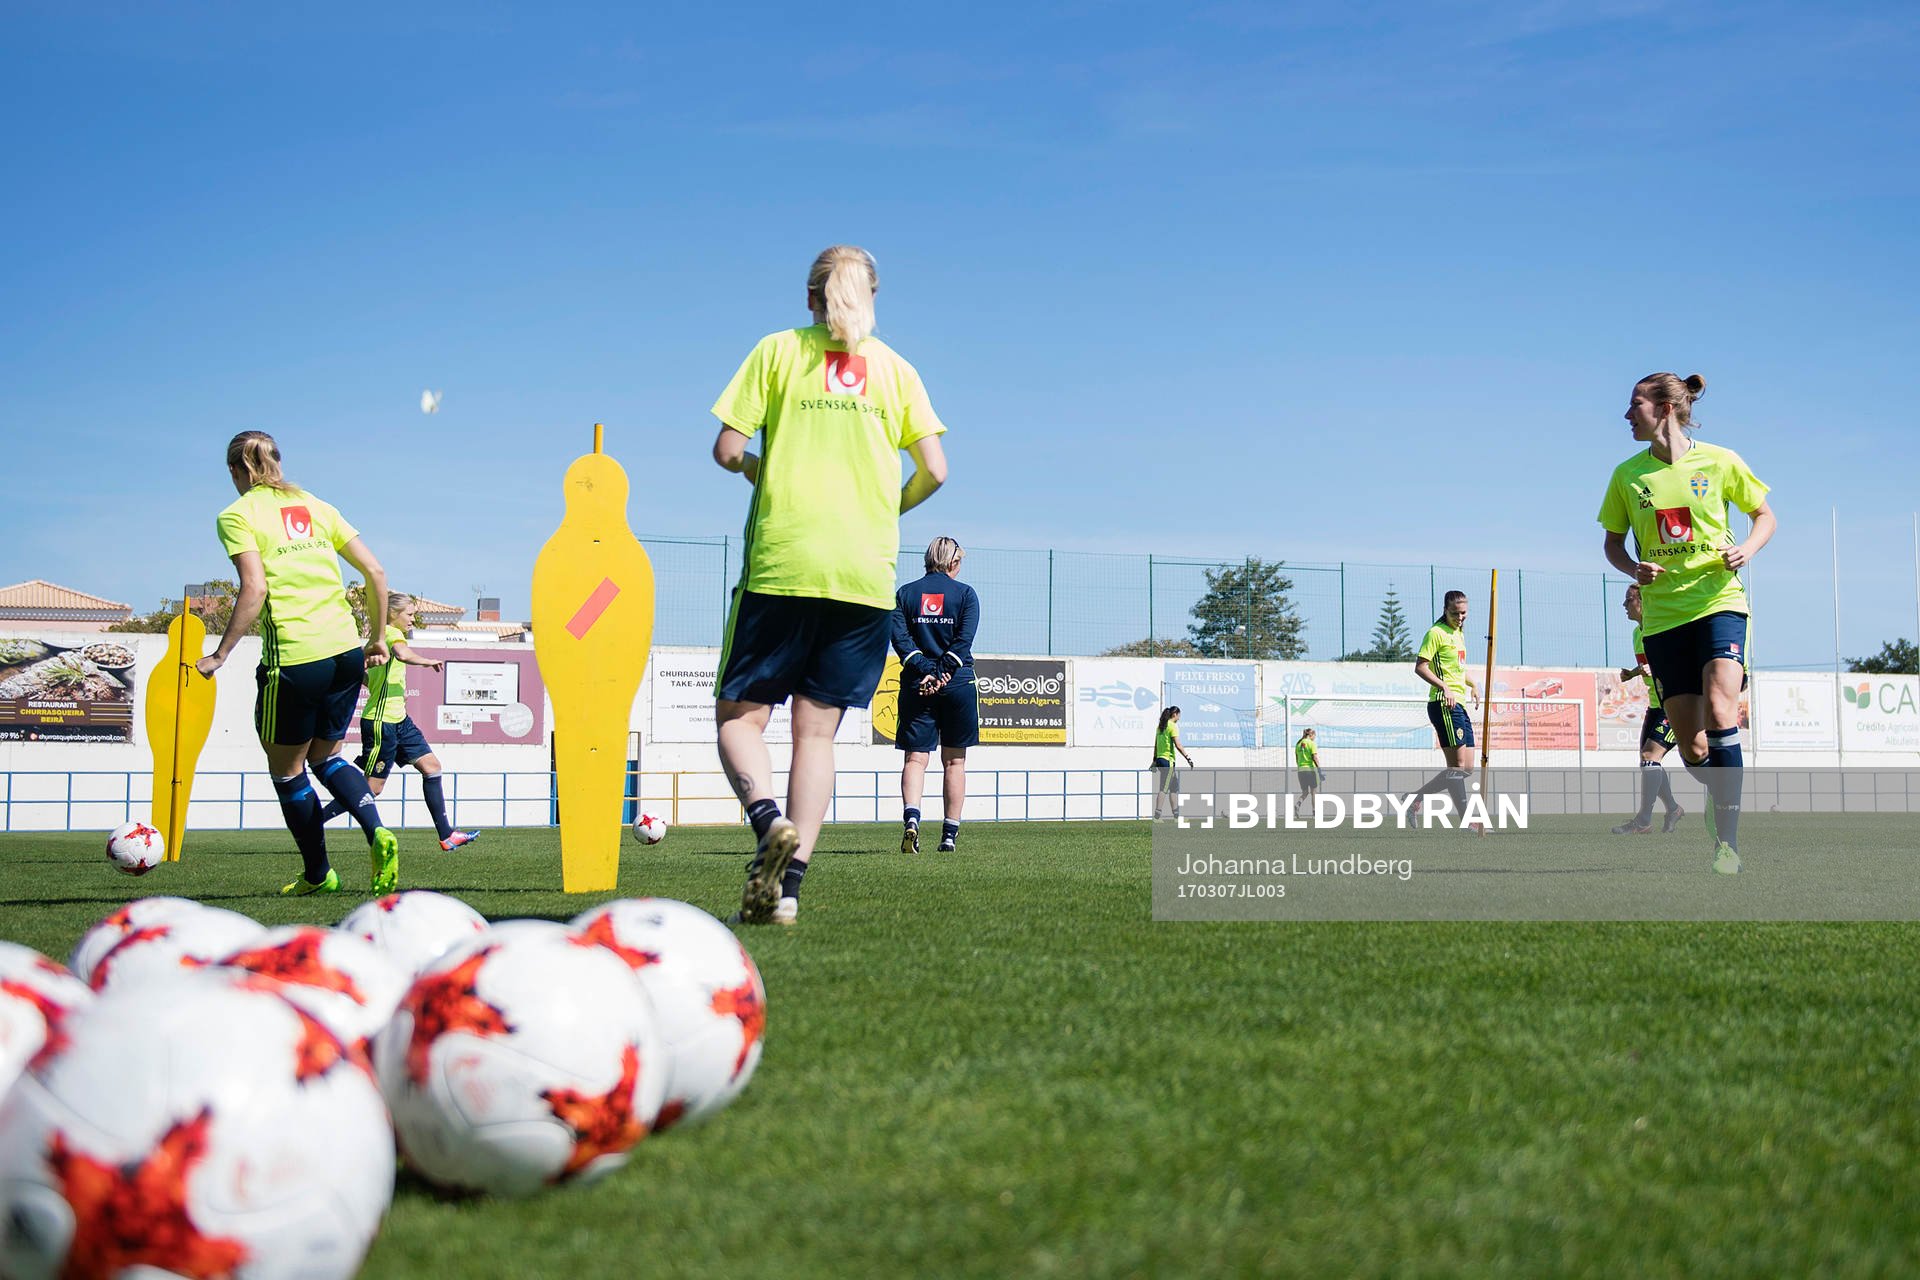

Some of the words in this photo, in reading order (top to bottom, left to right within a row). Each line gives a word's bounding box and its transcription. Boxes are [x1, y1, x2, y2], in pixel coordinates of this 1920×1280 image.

[800, 399, 858, 411] SVENSKA
[1639, 499, 1655, 510] ICA
[1649, 544, 1688, 558] SVENSKA
[659, 670, 717, 678] CHURRASQUE
[1175, 671, 1205, 681] PEIXE
[1206, 671, 1246, 682] FRESCO
[977, 674, 1061, 695] esbolo
[1181, 684, 1240, 695] GRELHADO
[979, 696, 1016, 707] regionais
[1017, 696, 1029, 705] do
[1029, 696, 1061, 707] Algarve
[1879, 682, 1917, 714] CA
[28, 701, 78, 709] RESTAURANTE
[20, 709, 86, 717] CHURRASQUEIRA
[984, 718, 998, 726] 572
[999, 718, 1013, 726] 112
[1020, 718, 1033, 726] 961
[1035, 718, 1048, 726] 569
[1049, 718, 1063, 726] 865
[1094, 716, 1104, 729] A
[1110, 716, 1144, 729] Nora
[1856, 721, 1887, 732] Crédito
[985, 731, 1060, 740] fresbolo@gmail.com
